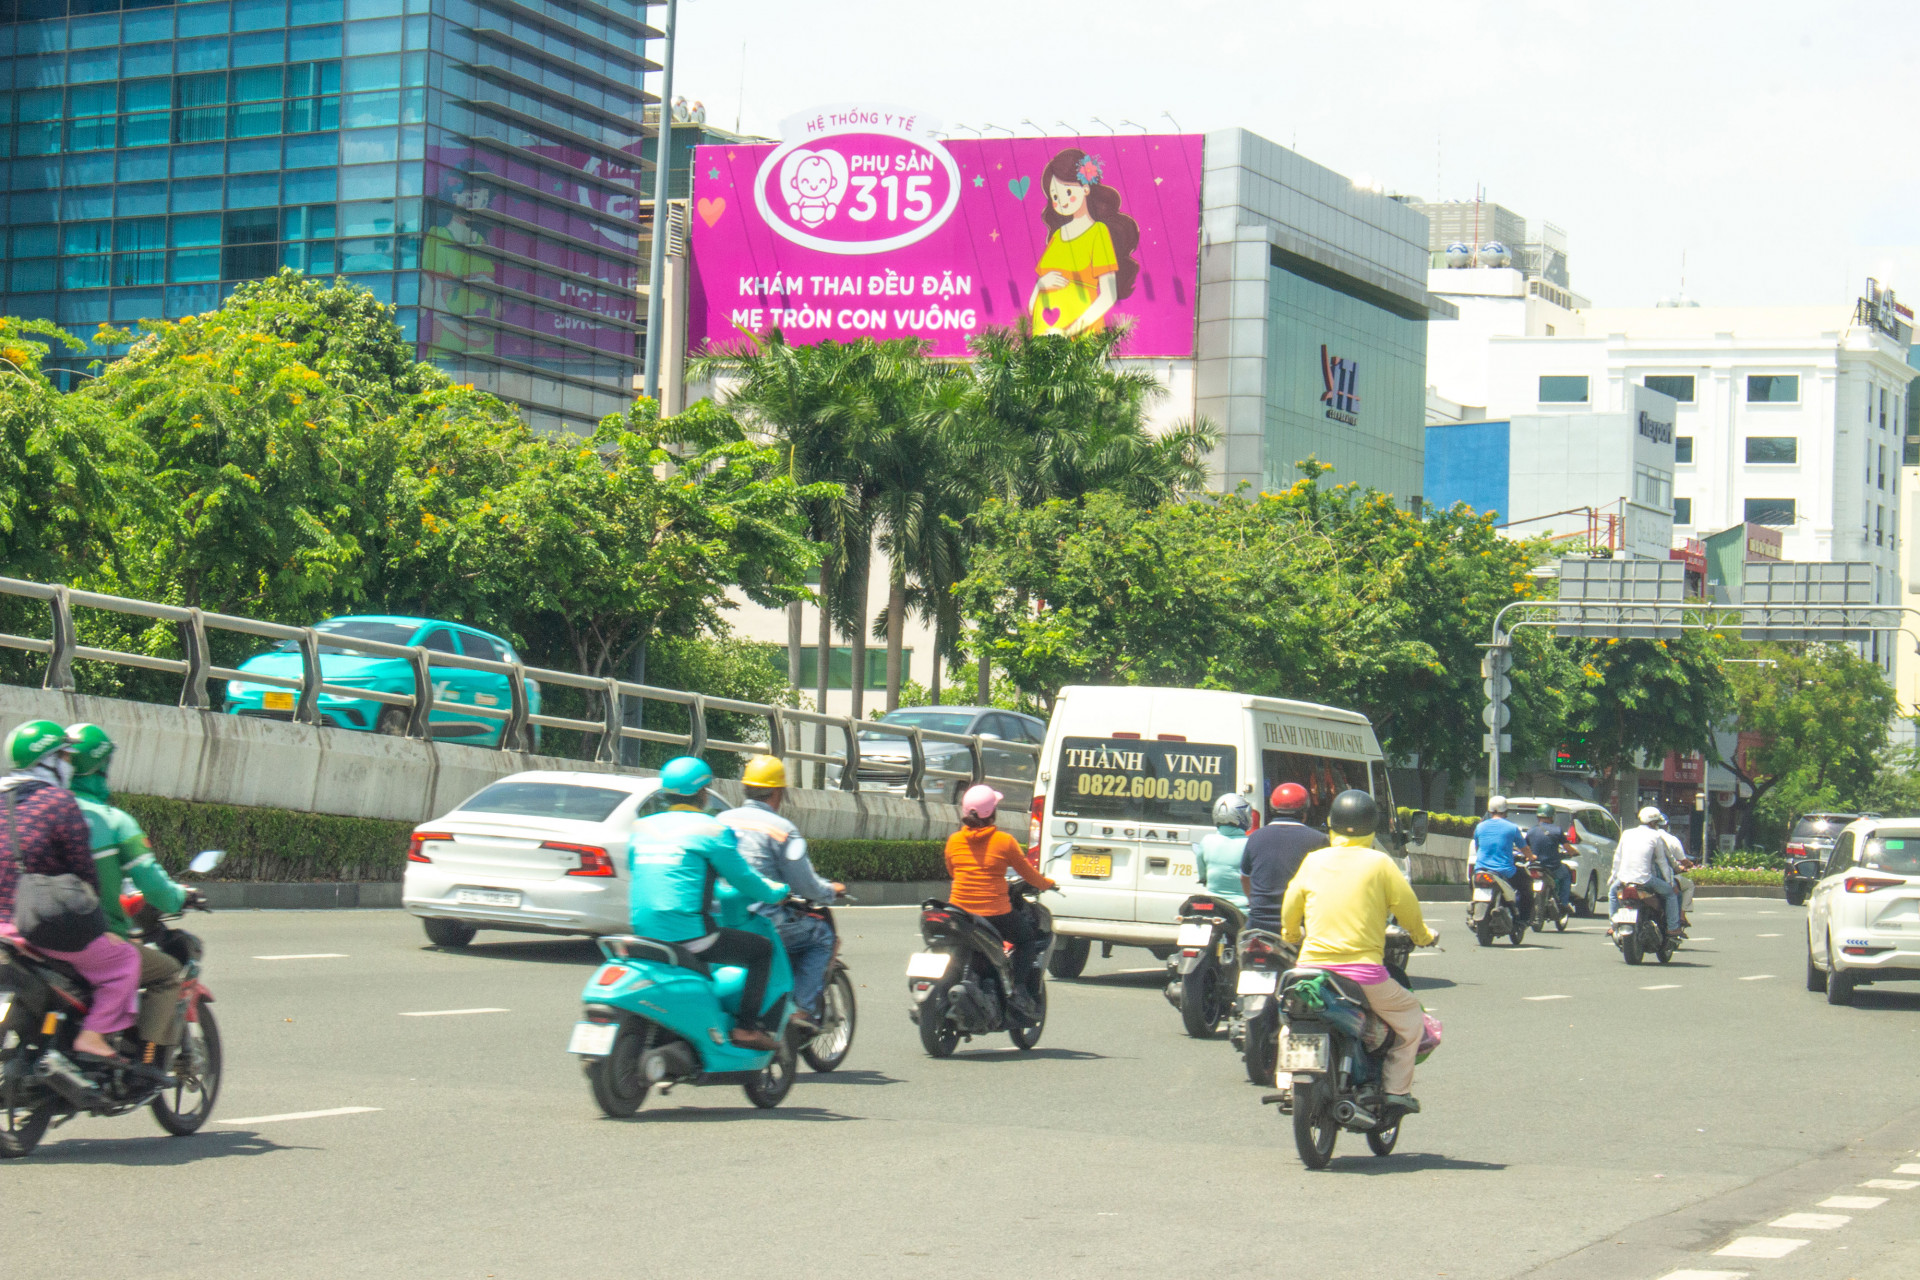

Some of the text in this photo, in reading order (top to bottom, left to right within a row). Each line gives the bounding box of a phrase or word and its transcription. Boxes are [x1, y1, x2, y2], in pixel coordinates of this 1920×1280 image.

[807, 107, 917, 132] HỆ THỐNG Y TẾ
[851, 149, 934, 176] PHỤ SẢN
[848, 175, 932, 222] 315
[739, 268, 971, 300] KHÁM THAI ĐỀU ĐẶN
[732, 303, 976, 333] MẸ TRÒN CON VUÔNG
[1263, 716, 1366, 755] THÀNH VINH LIMOUSINE
[1066, 743, 1222, 775] THÀNH VINH
[1078, 773, 1213, 802] 0822.600.300
